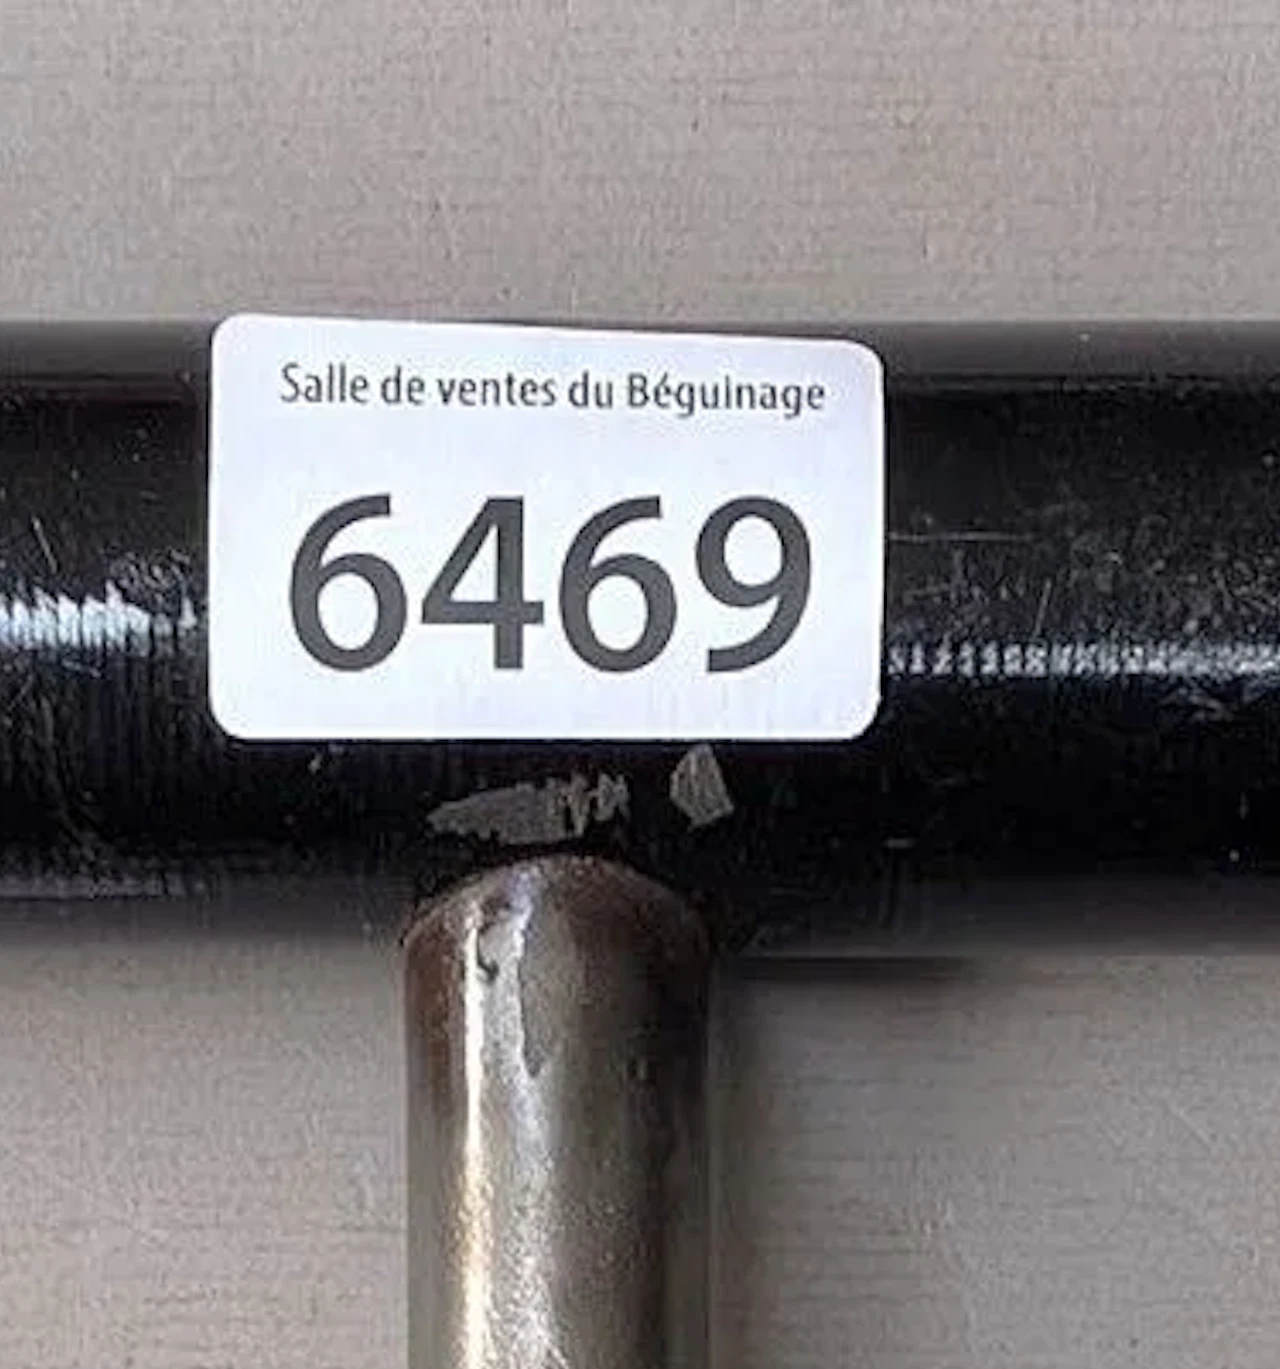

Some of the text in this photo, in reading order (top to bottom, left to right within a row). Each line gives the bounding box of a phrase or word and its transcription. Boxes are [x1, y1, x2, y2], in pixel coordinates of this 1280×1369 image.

[280, 362, 826, 418] Salle de ventes du Béguinage
[289, 494, 811, 673] 6469
